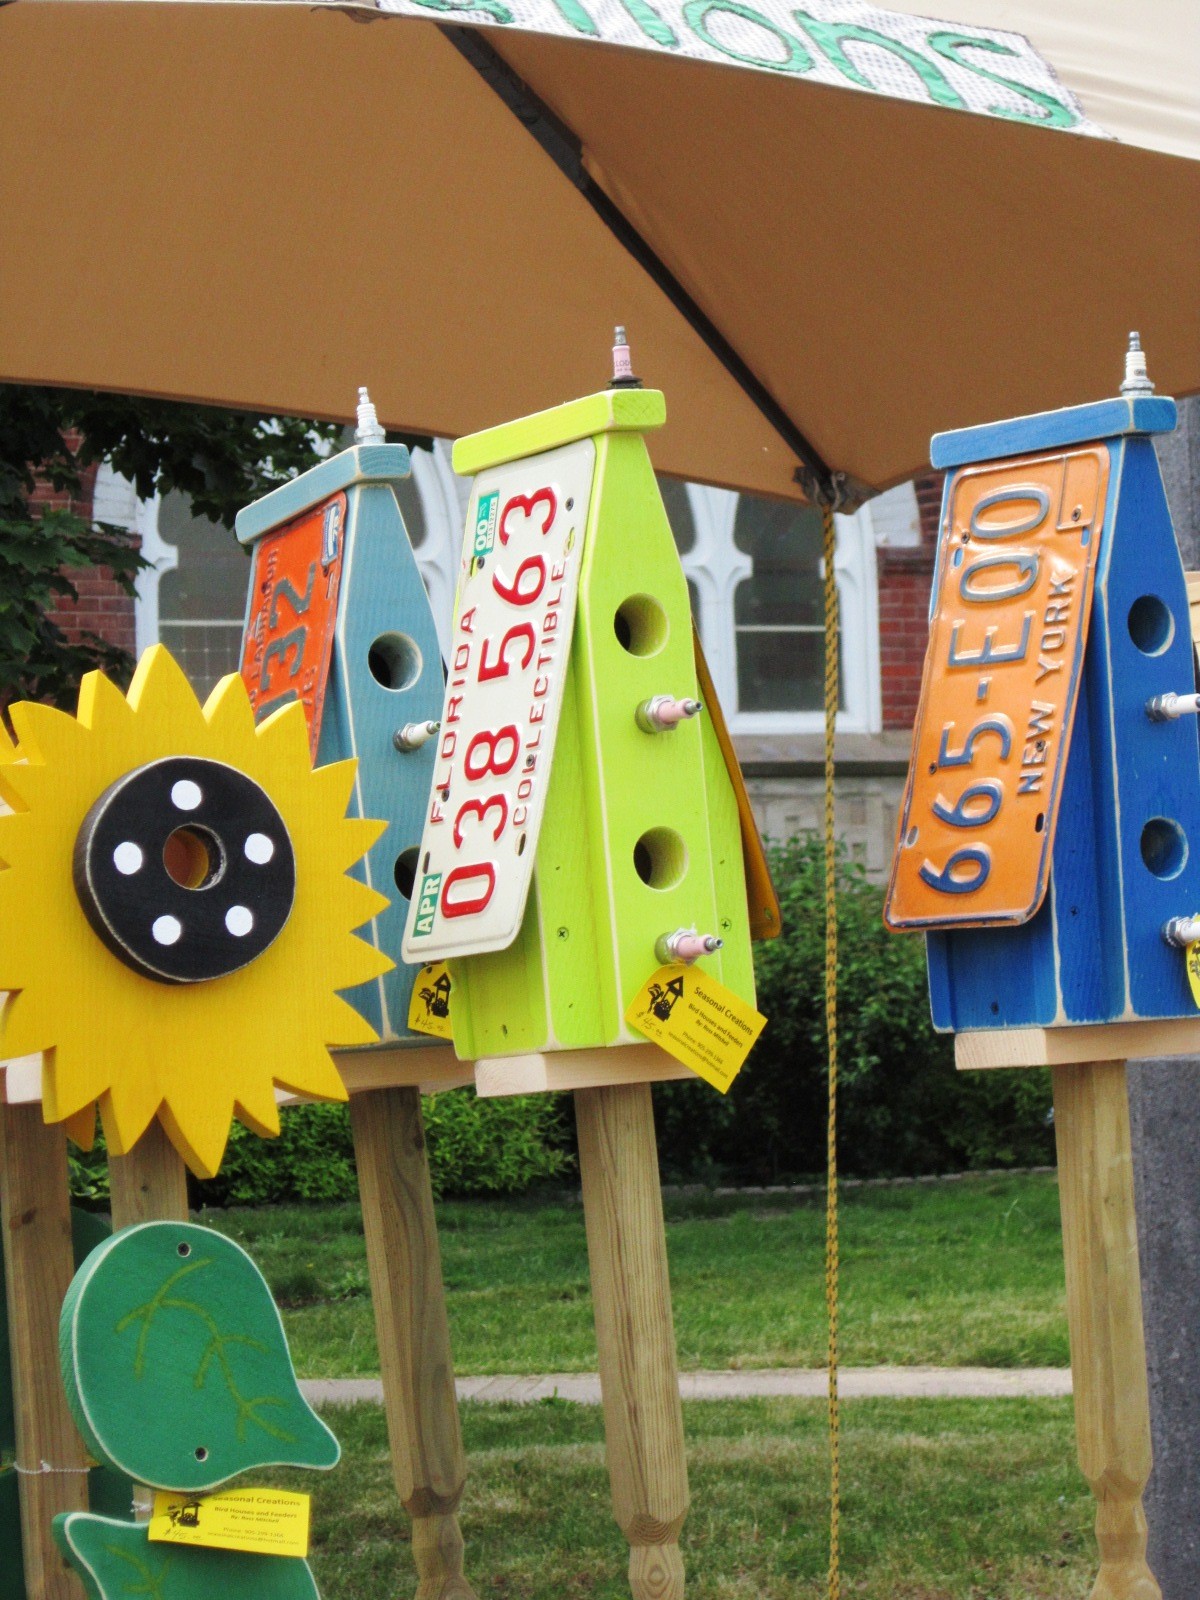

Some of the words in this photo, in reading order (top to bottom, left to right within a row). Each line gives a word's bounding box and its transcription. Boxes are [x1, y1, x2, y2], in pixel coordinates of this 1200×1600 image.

[1035, 568, 1078, 682] YORK
[430, 606, 478, 824] FLORIDA
[513, 560, 567, 826] COLLECTIBLE
[1017, 700, 1056, 795] NEW
[416, 875, 440, 933] APR
[688, 1003, 700, 1014] Bird
[698, 1010, 717, 1027] Houses
[716, 1024, 728, 1035] and
[726, 1030, 744, 1048] Feeders
[694, 986, 725, 1013] Seasonal
[724, 1008, 754, 1036] Creations
[229, 1507, 255, 1516] Houses
[256, 1509, 269, 1517] and
[270, 1511, 297, 1519] Feeders
[256, 1496, 301, 1506] Creations
